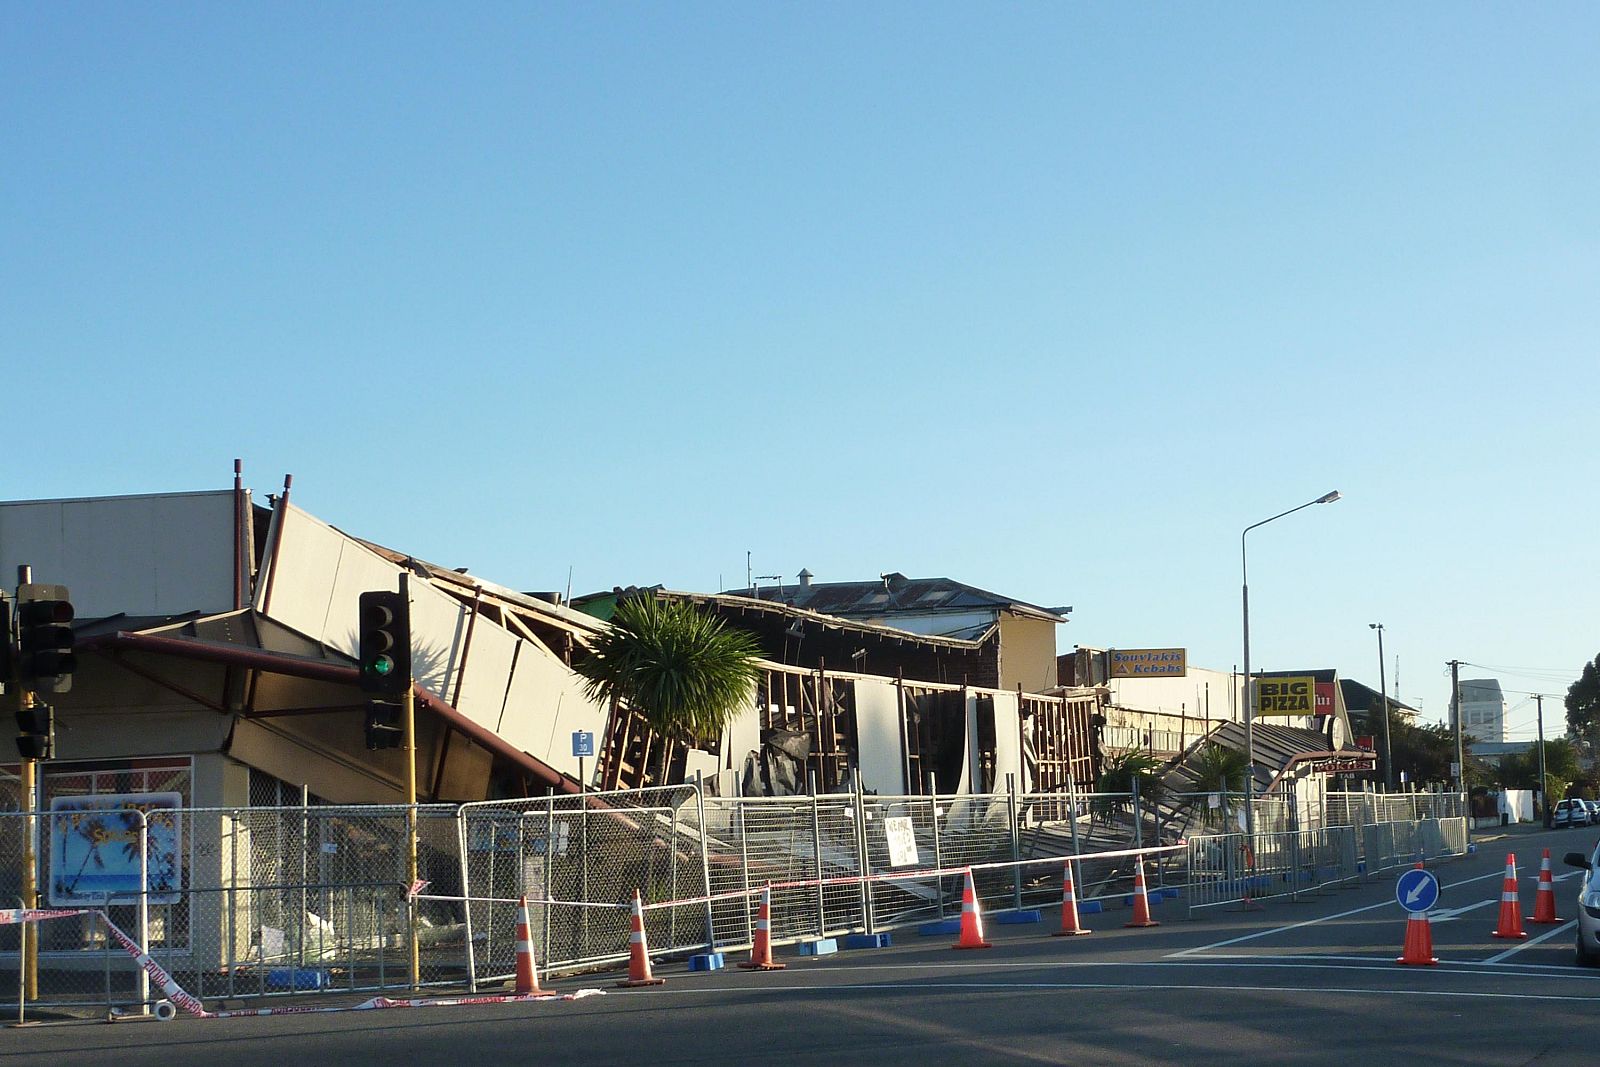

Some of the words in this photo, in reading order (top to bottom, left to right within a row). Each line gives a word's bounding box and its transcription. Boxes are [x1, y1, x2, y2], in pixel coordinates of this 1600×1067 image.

[1113, 651, 1182, 663] Souvlakis
[1134, 663, 1182, 673] Kebabs
[1260, 682, 1308, 696] BIG
[1260, 695, 1310, 712] PIZZA
[579, 733, 588, 743] P
[143, 958, 170, 988] POLICE
